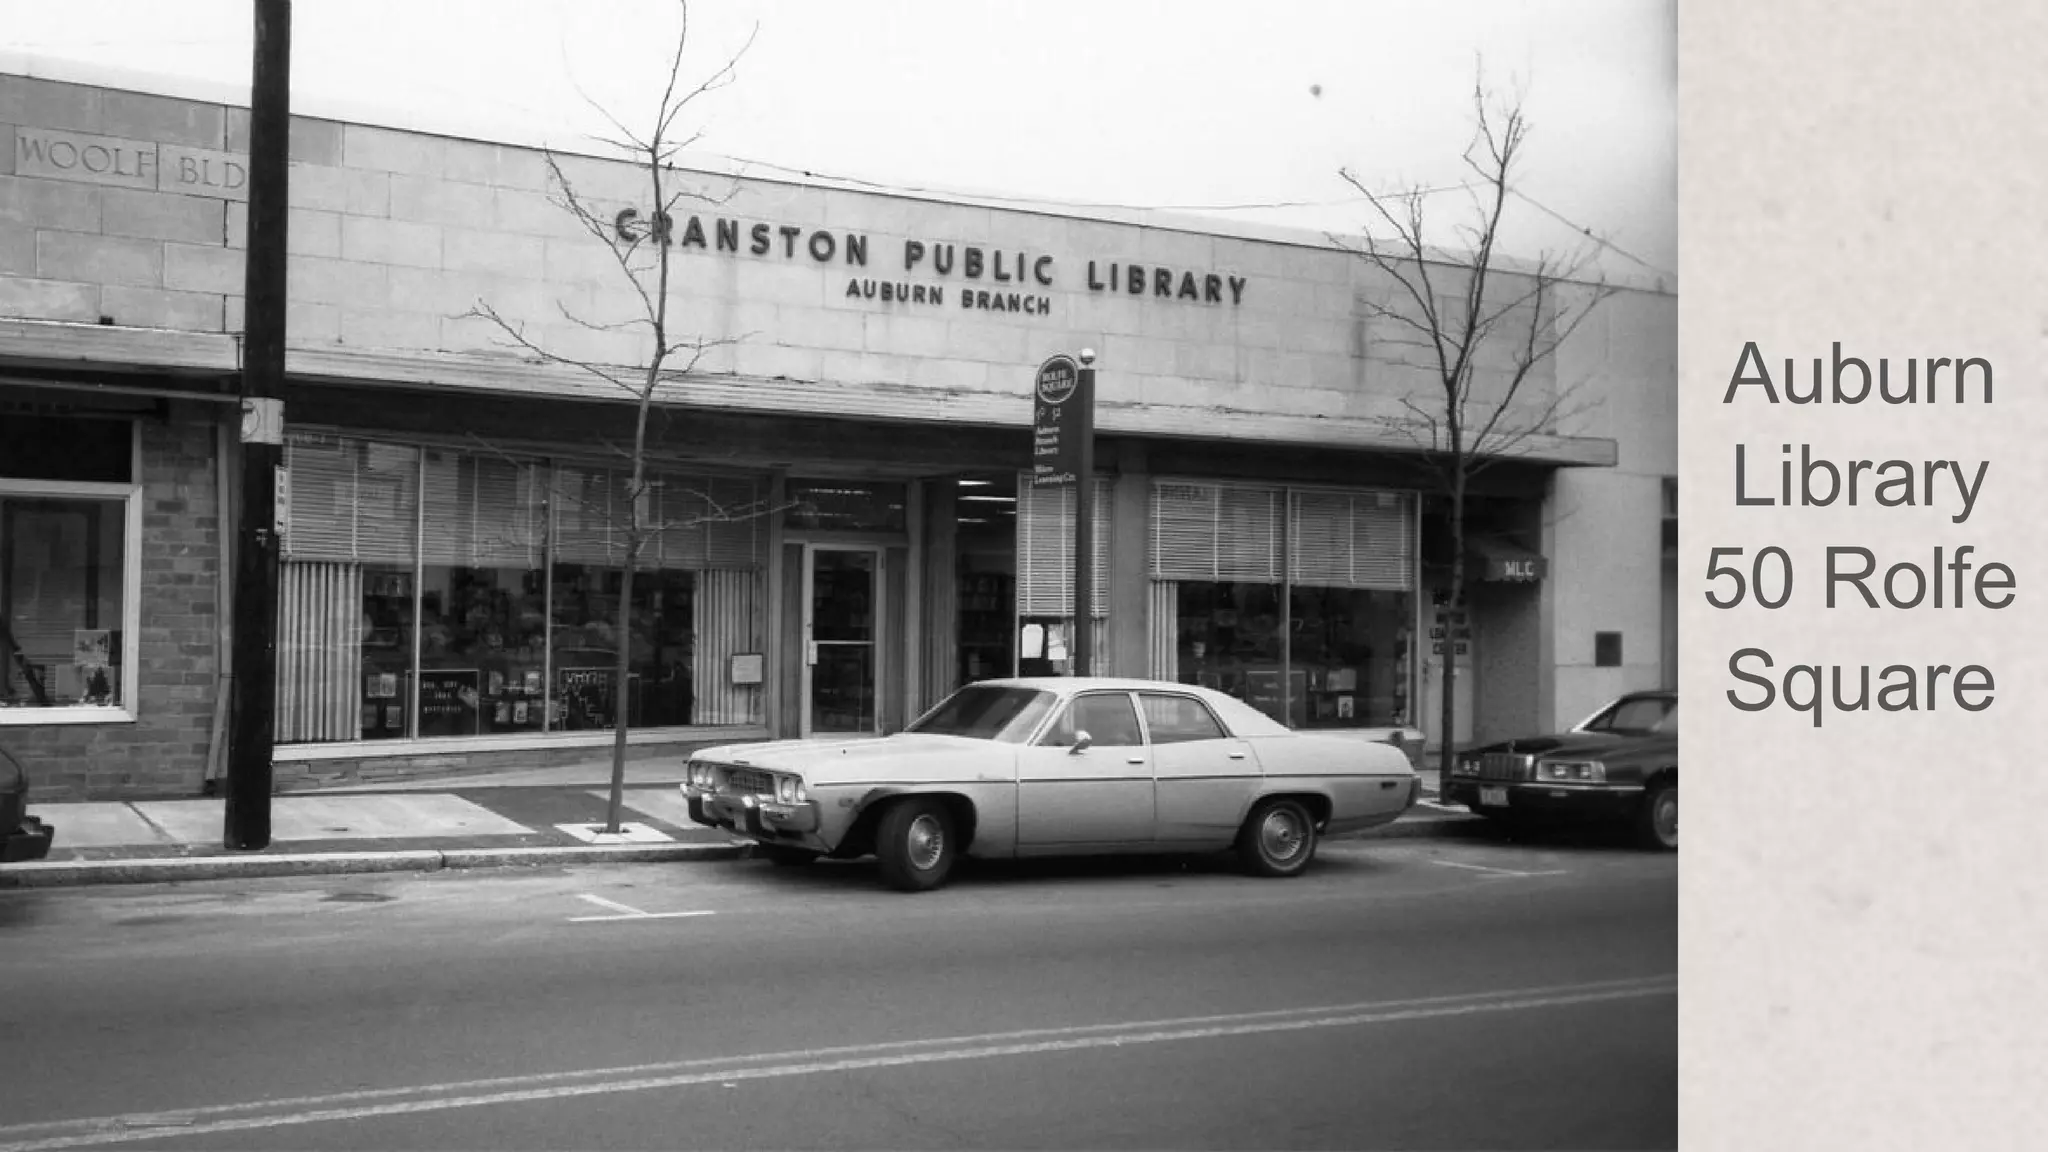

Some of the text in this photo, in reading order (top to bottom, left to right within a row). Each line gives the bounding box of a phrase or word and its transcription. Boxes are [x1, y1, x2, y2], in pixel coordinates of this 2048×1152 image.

[19, 136, 155, 178] WOOLF
[615, 207, 1248, 306] CRANSTON PUBLIC LIBRARY
[846, 278, 1051, 315] AUBURN BRANCH
